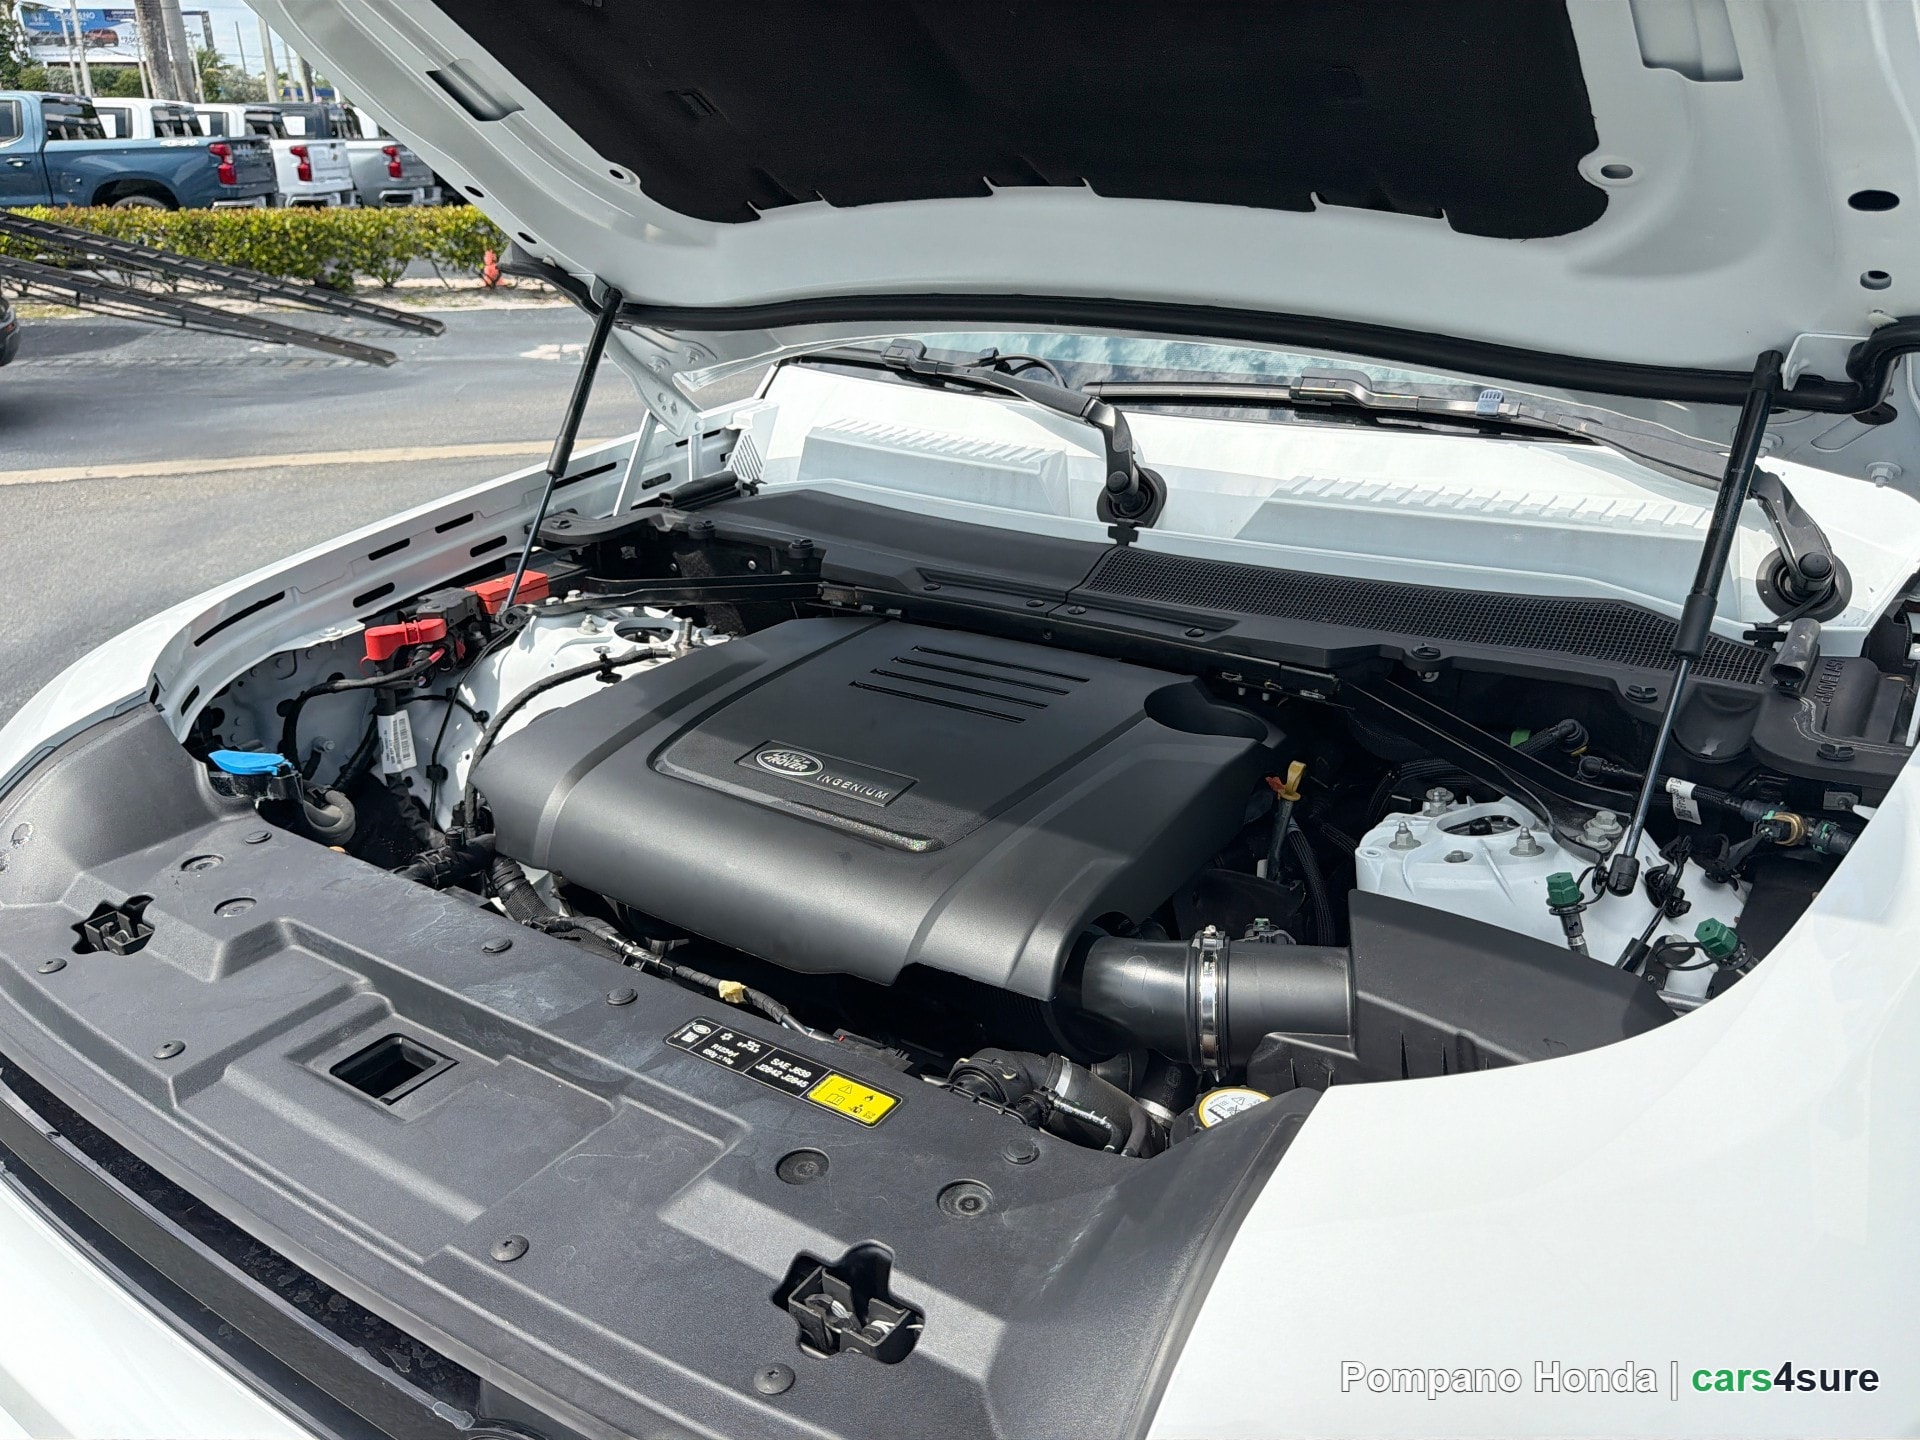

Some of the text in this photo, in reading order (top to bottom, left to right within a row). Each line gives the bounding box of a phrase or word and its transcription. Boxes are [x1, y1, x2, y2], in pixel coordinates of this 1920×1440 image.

[769, 755, 809, 772] ROVER
[816, 773, 891, 800] INGENIUM
[755, 1064, 783, 1077] J2842
[770, 1058, 812, 1078] SAE J639
